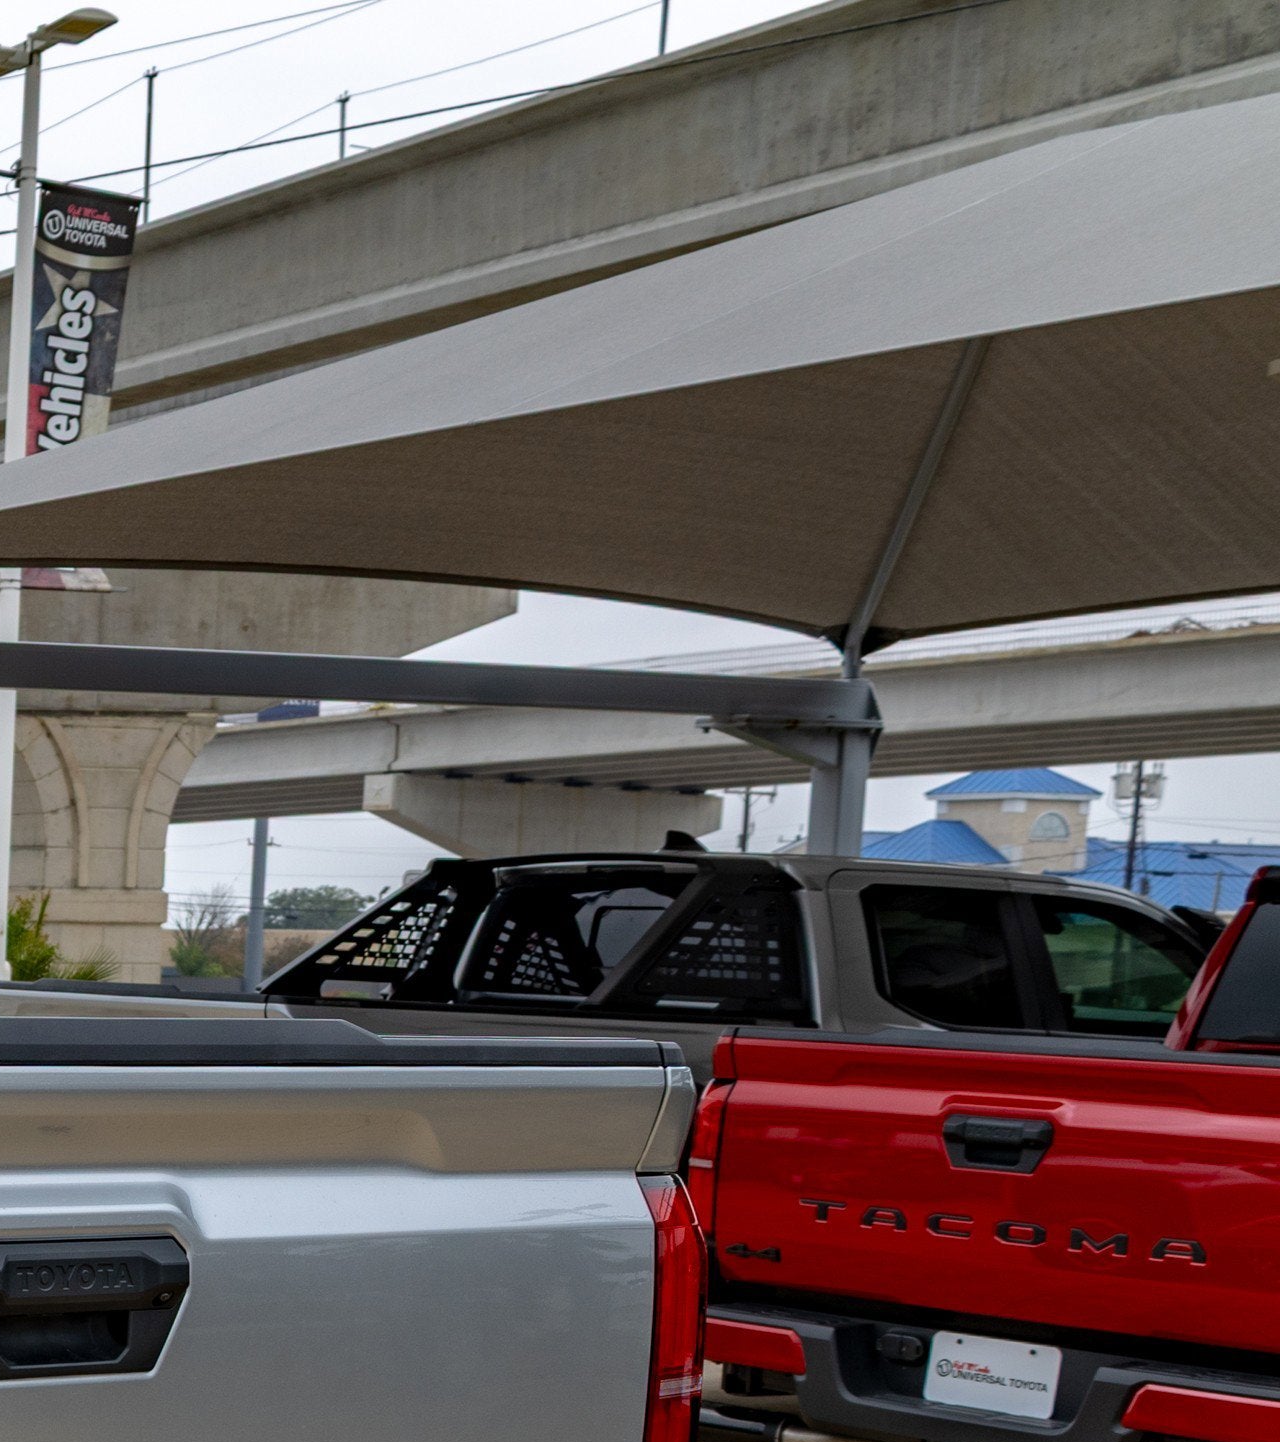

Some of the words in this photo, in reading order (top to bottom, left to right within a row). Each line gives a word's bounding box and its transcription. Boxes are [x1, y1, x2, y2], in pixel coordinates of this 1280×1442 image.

[65, 215, 129, 239] UNIVERSAL
[65, 229, 107, 248] TOYOTA
[798, 1198, 1208, 1267] TACOMA
[16, 1263, 134, 1292] TOYOTA
[952, 1370, 1007, 1386] UNIVERSAL
[1009, 1378, 1048, 1392] TOYOTA
